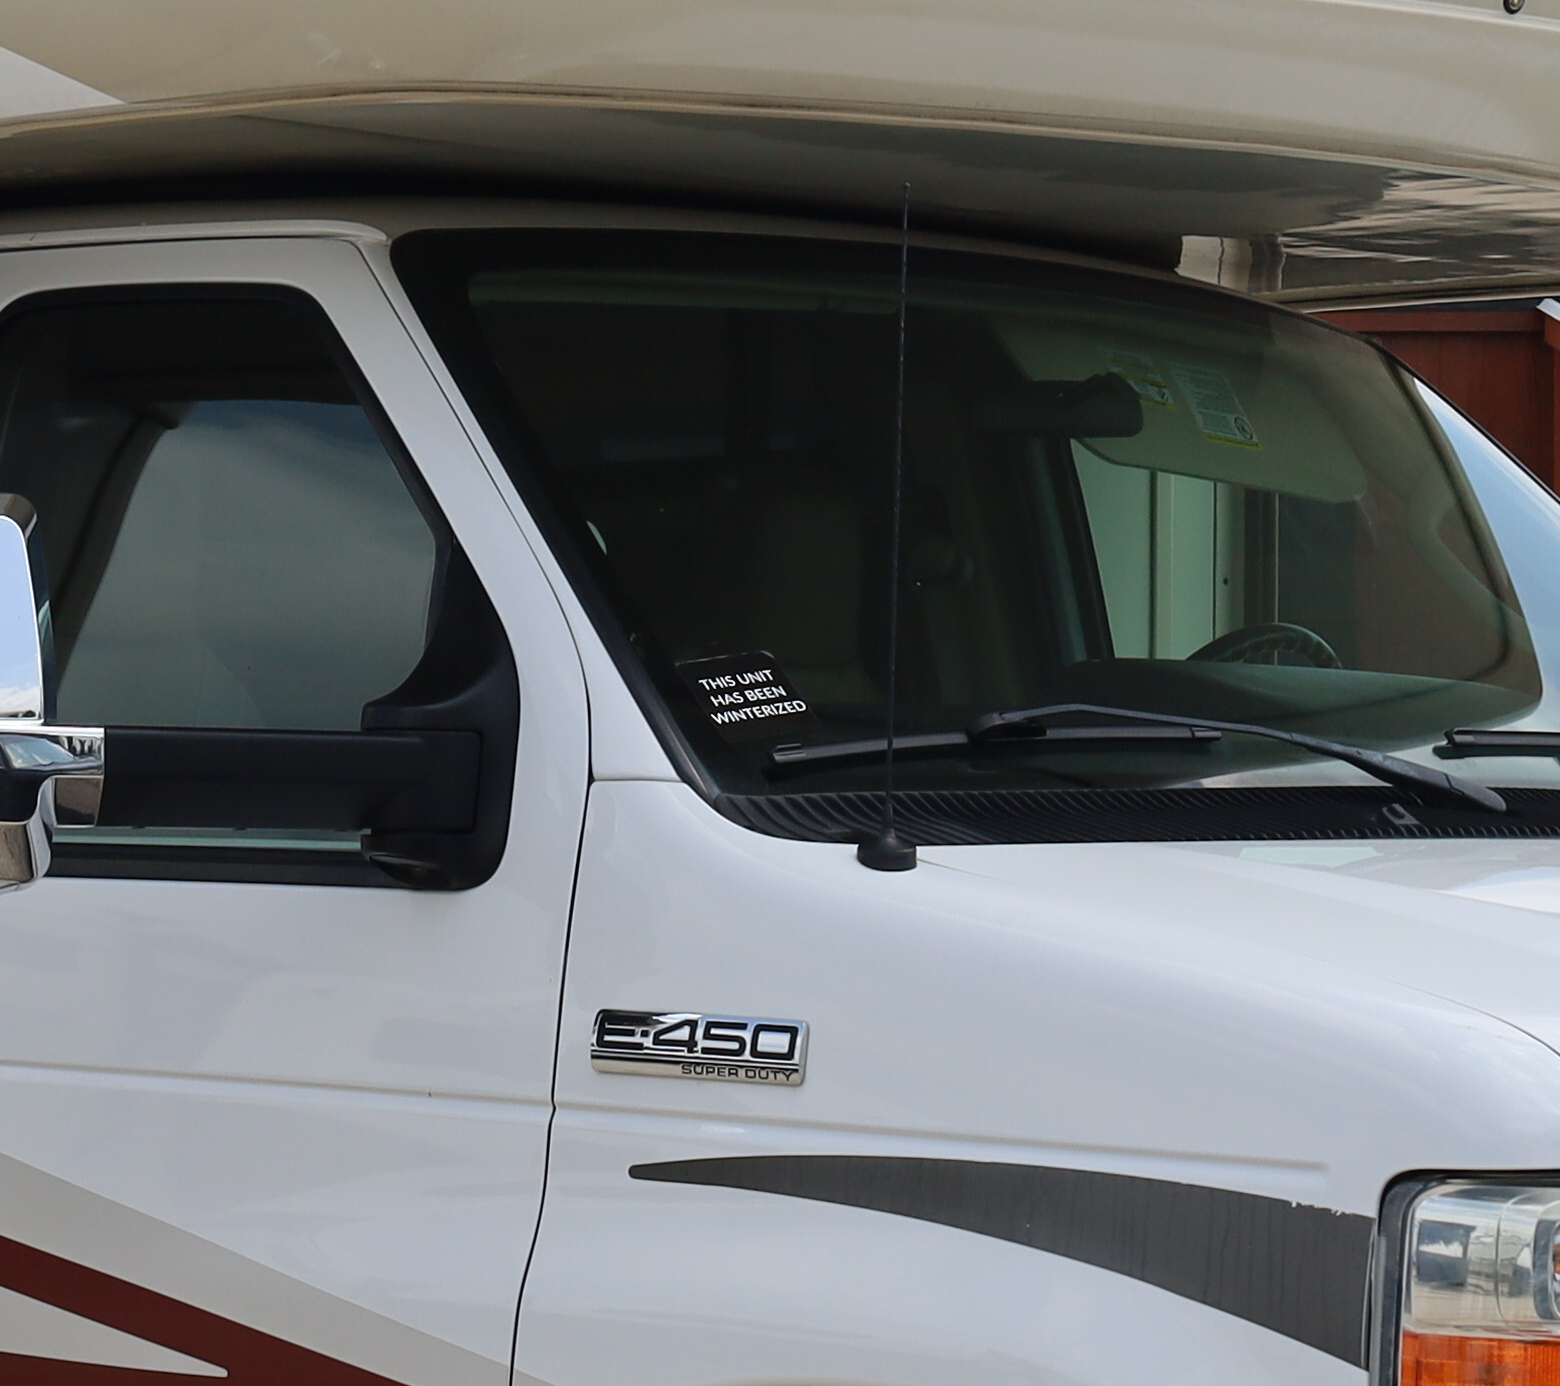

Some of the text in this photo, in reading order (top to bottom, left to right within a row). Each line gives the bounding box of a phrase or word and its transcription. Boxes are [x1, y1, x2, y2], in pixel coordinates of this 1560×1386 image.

[699, 669, 774, 691] THIS UNIT
[710, 685, 787, 707] HAS BEEN
[711, 700, 806, 725] WINTERIZED
[681, 1063, 796, 1081] SUPER DUTY
